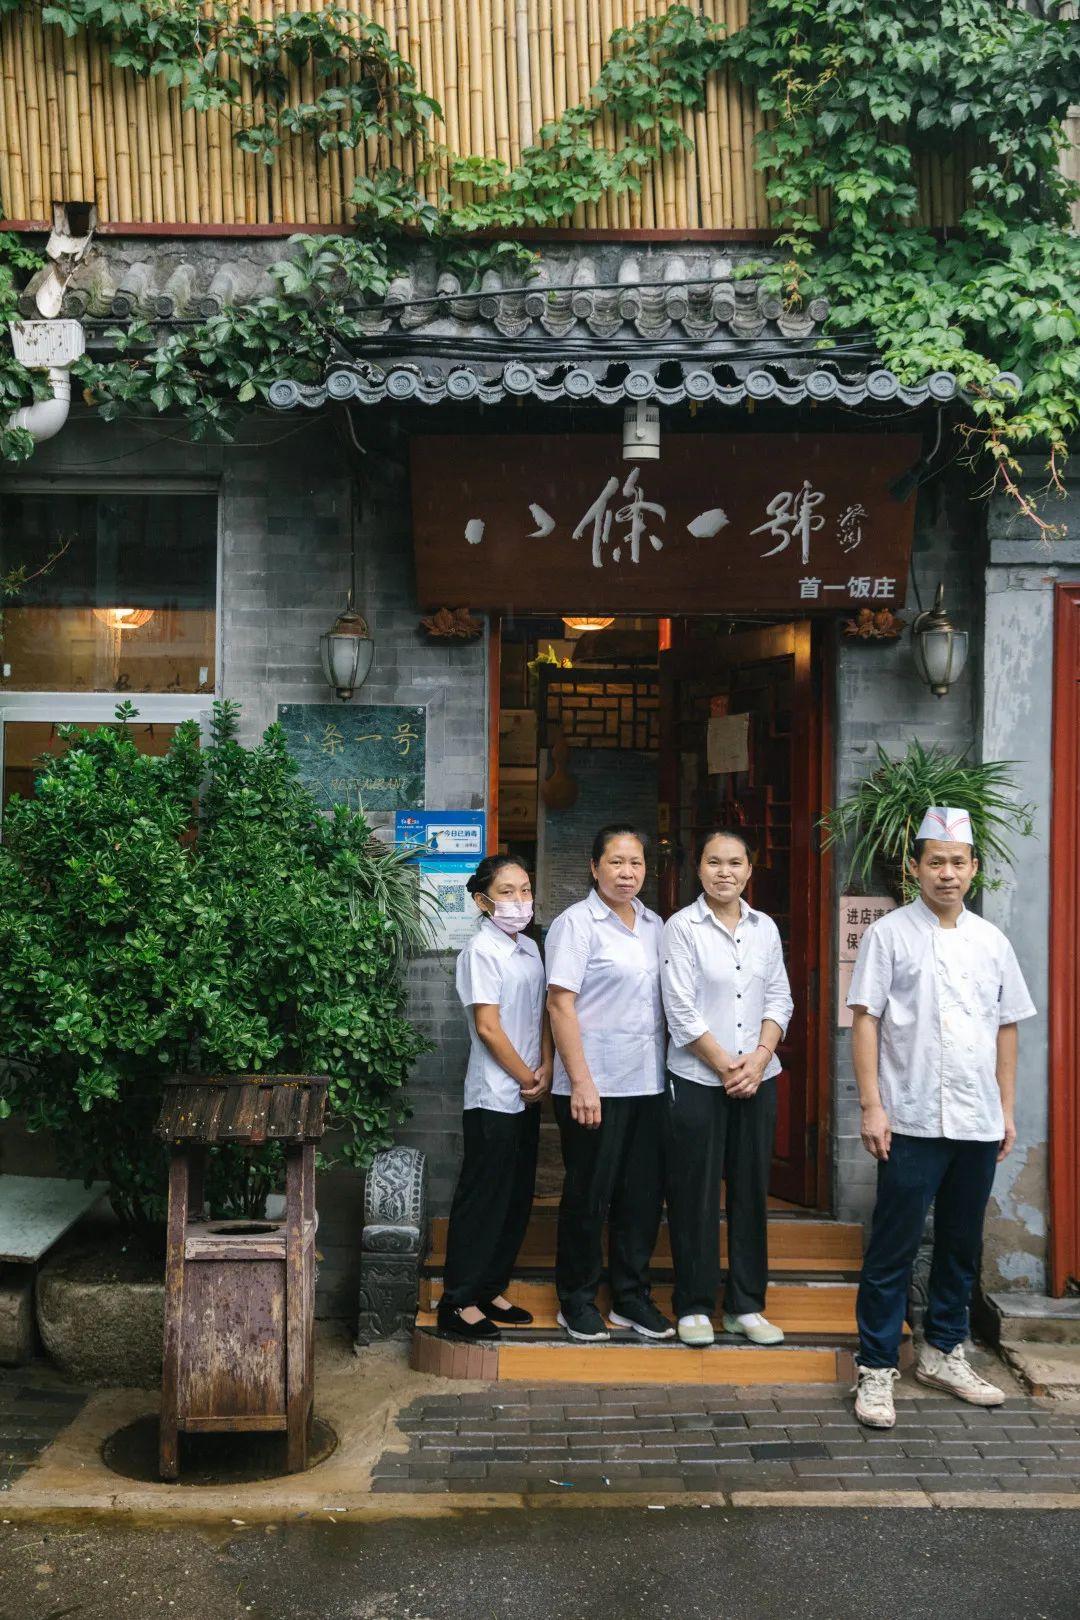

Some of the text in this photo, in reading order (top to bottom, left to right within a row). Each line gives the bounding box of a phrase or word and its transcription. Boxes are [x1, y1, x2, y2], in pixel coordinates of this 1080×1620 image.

[798, 576, 896, 599] 首一饭庄
[444, 829, 478, 838] 今日已消毒
[846, 932, 864, 950] 保
